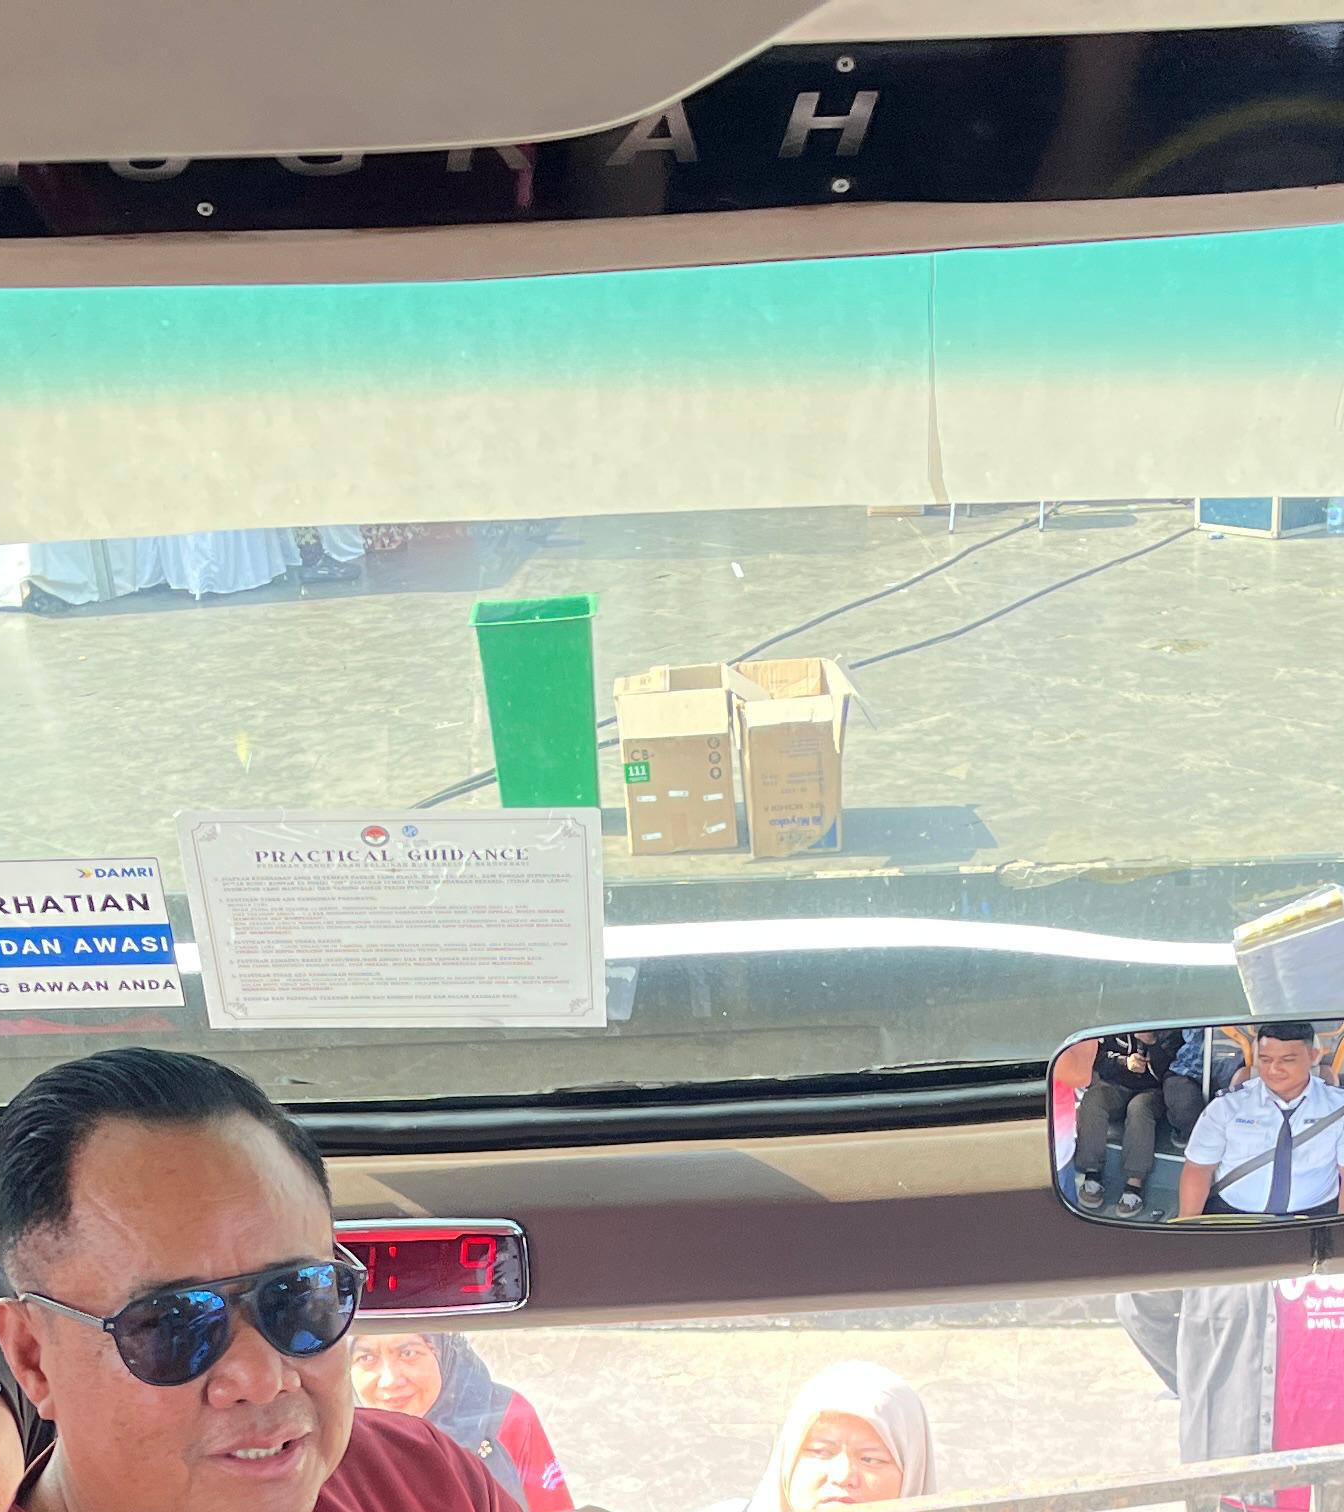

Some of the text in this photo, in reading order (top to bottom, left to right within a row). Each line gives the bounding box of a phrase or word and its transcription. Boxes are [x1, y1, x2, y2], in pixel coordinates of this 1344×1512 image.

[255, 848, 529, 863] PRACTICAL GUIDANCE
[94, 867, 154, 879] DAMRI
[0, 938, 62, 955] DAN
[74, 936, 170, 954] AWASI
[18, 980, 109, 994] BAWAAN
[118, 979, 176, 991] ANDA
